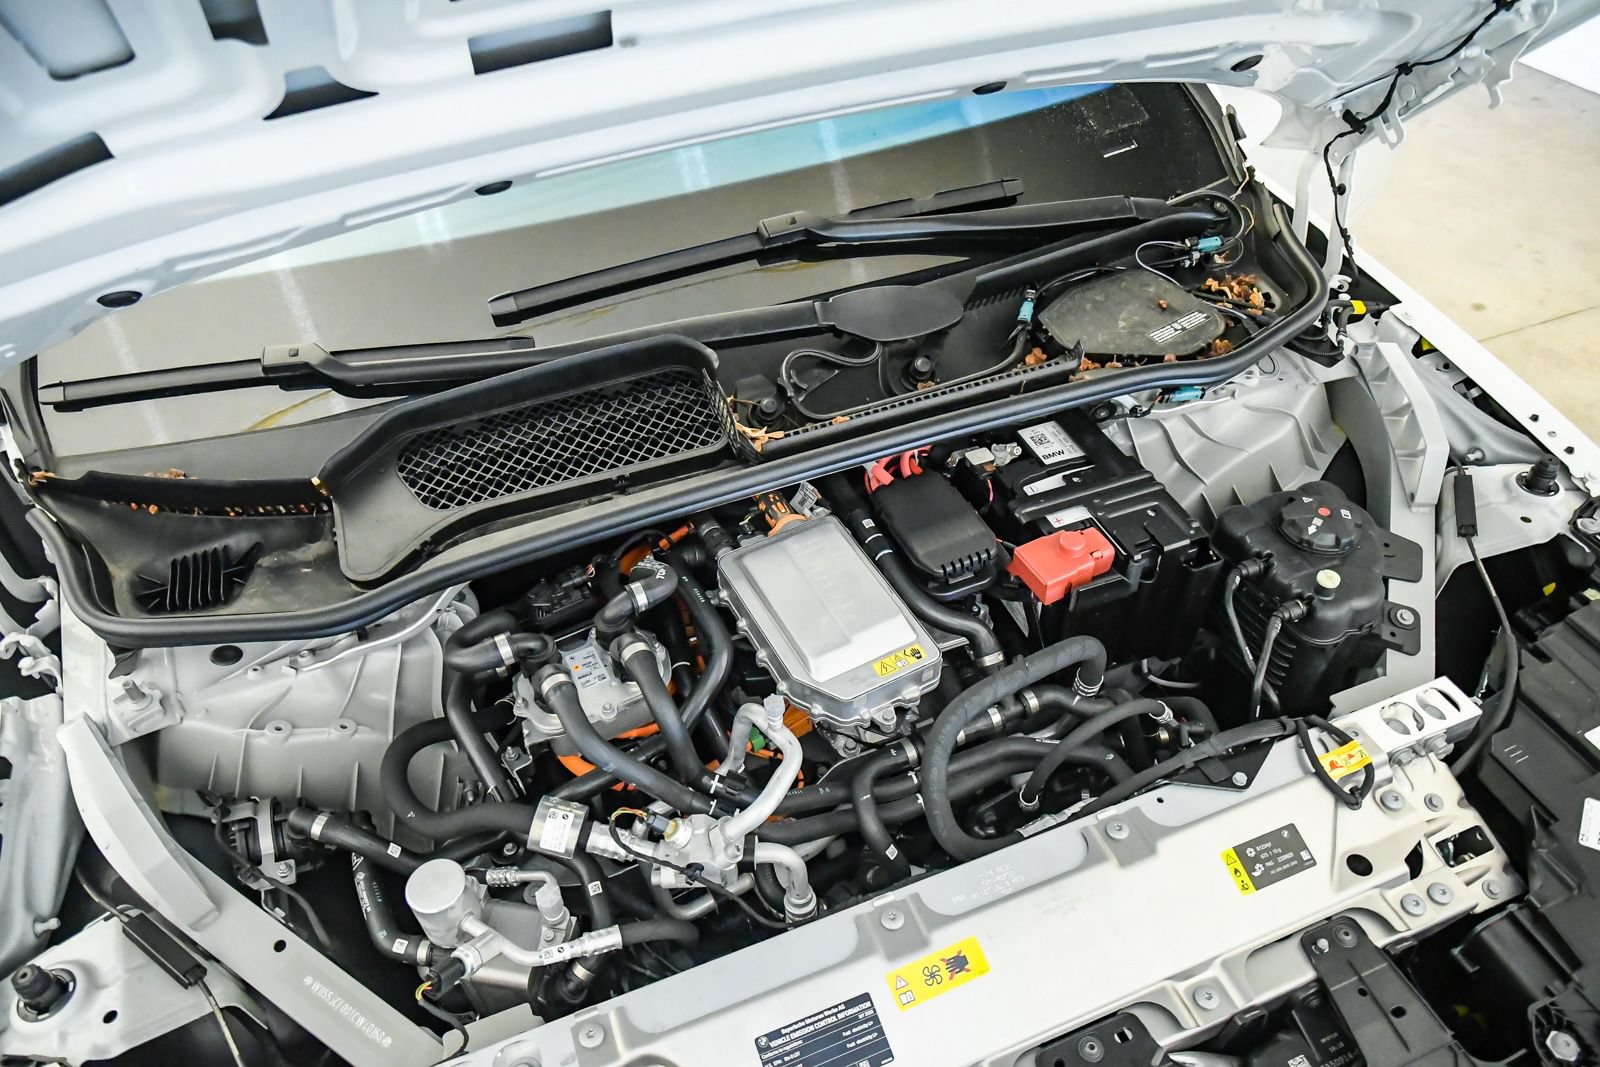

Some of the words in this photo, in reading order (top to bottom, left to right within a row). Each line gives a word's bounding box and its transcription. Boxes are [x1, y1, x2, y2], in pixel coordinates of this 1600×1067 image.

[1042, 450, 1065, 460] BMW
[805, 1014, 824, 1024] Motoren
[824, 1008, 838, 1016] Werke
[769, 1035, 790, 1048] VEHICLE
[790, 1025, 815, 1040] EMISSION
[814, 1016, 838, 1029] CONTROL
[837, 1001, 871, 1019] INFORMATION
